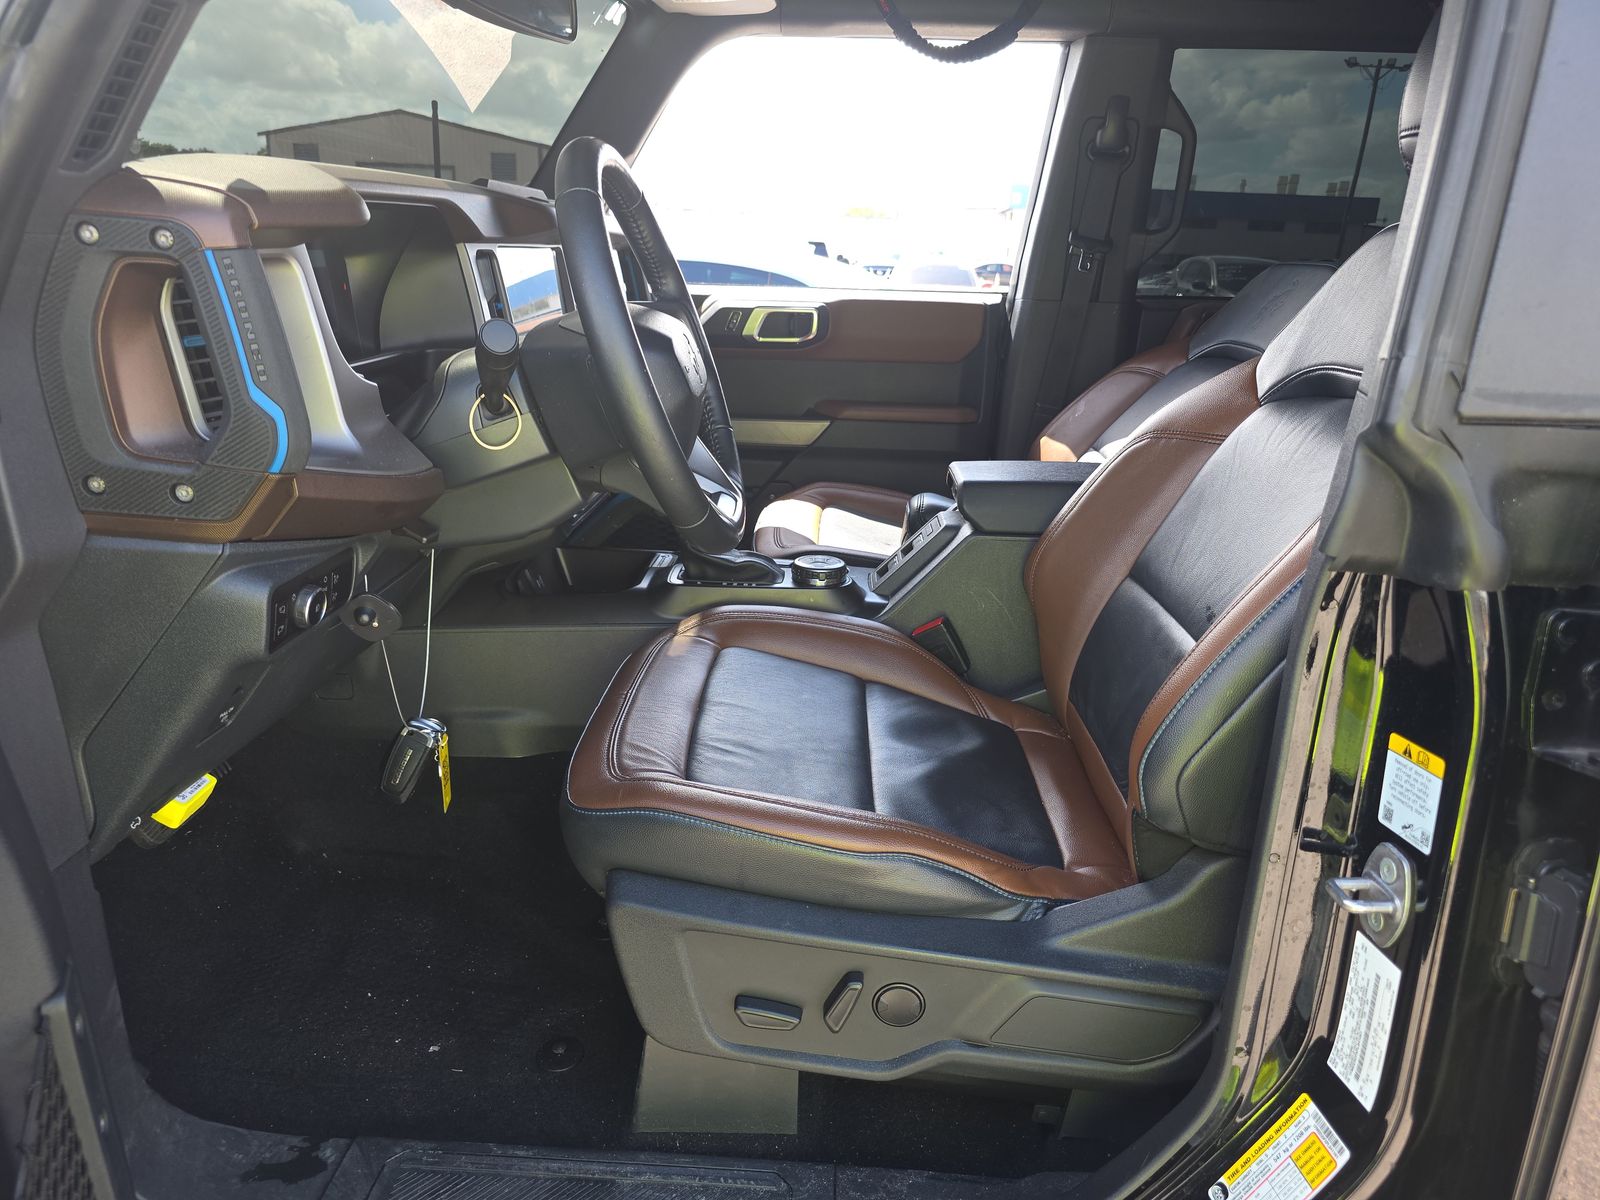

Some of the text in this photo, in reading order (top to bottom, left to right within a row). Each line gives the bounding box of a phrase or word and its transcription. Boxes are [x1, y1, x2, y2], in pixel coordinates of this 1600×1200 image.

[223, 257, 268, 382] BRONCO
[1227, 1169, 1241, 1182] TIRE
[1240, 1157, 1252, 1170] AND
[1251, 1135, 1275, 1158] LOADING
[1274, 1098, 1308, 1135] INFORMATION
